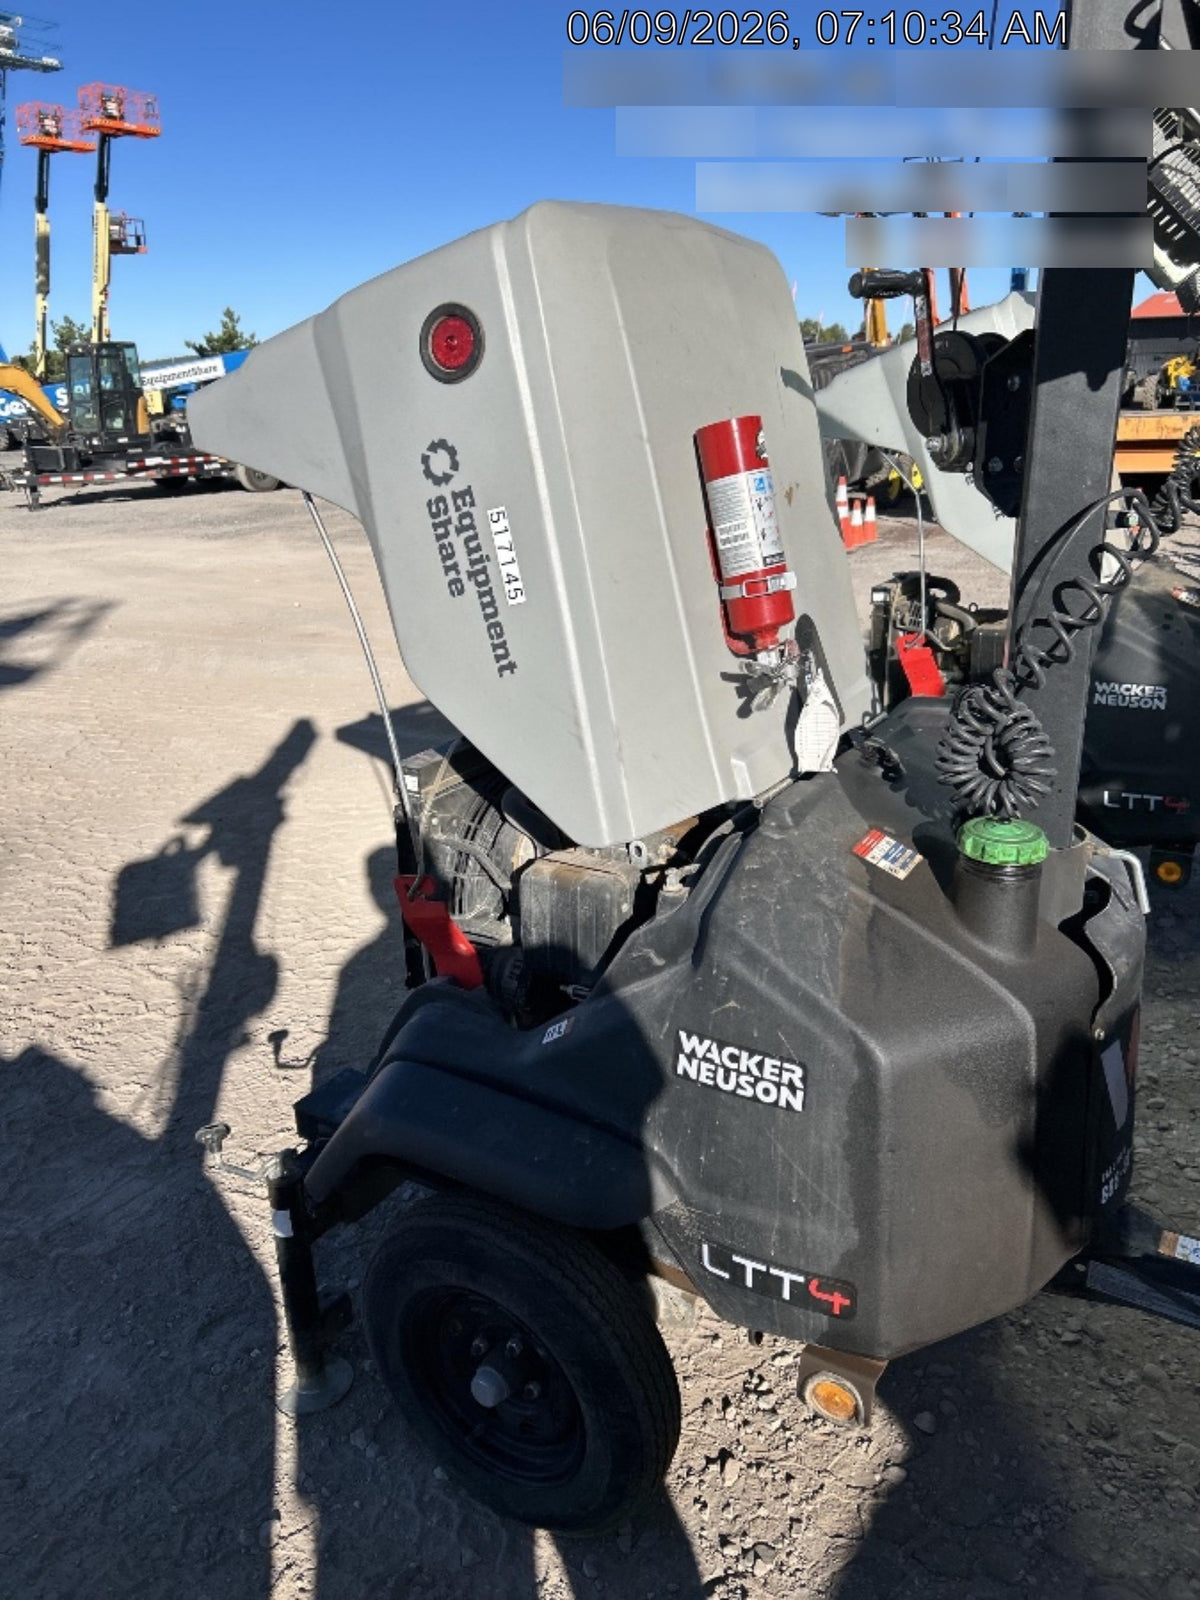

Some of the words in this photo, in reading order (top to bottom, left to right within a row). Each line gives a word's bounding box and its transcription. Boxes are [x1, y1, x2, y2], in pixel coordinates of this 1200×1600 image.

[426, 495, 466, 598] Share
[490, 510, 524, 600] 517145
[451, 485, 518, 678] Equipment
[1093, 693, 1167, 710] NEUSON
[1095, 682, 1167, 698] WACKER
[1103, 790, 1190, 814] LTT4
[676, 1053, 804, 1112] NEUSON
[678, 1029, 804, 1088] WACKER
[702, 1243, 851, 1315] LTT4
